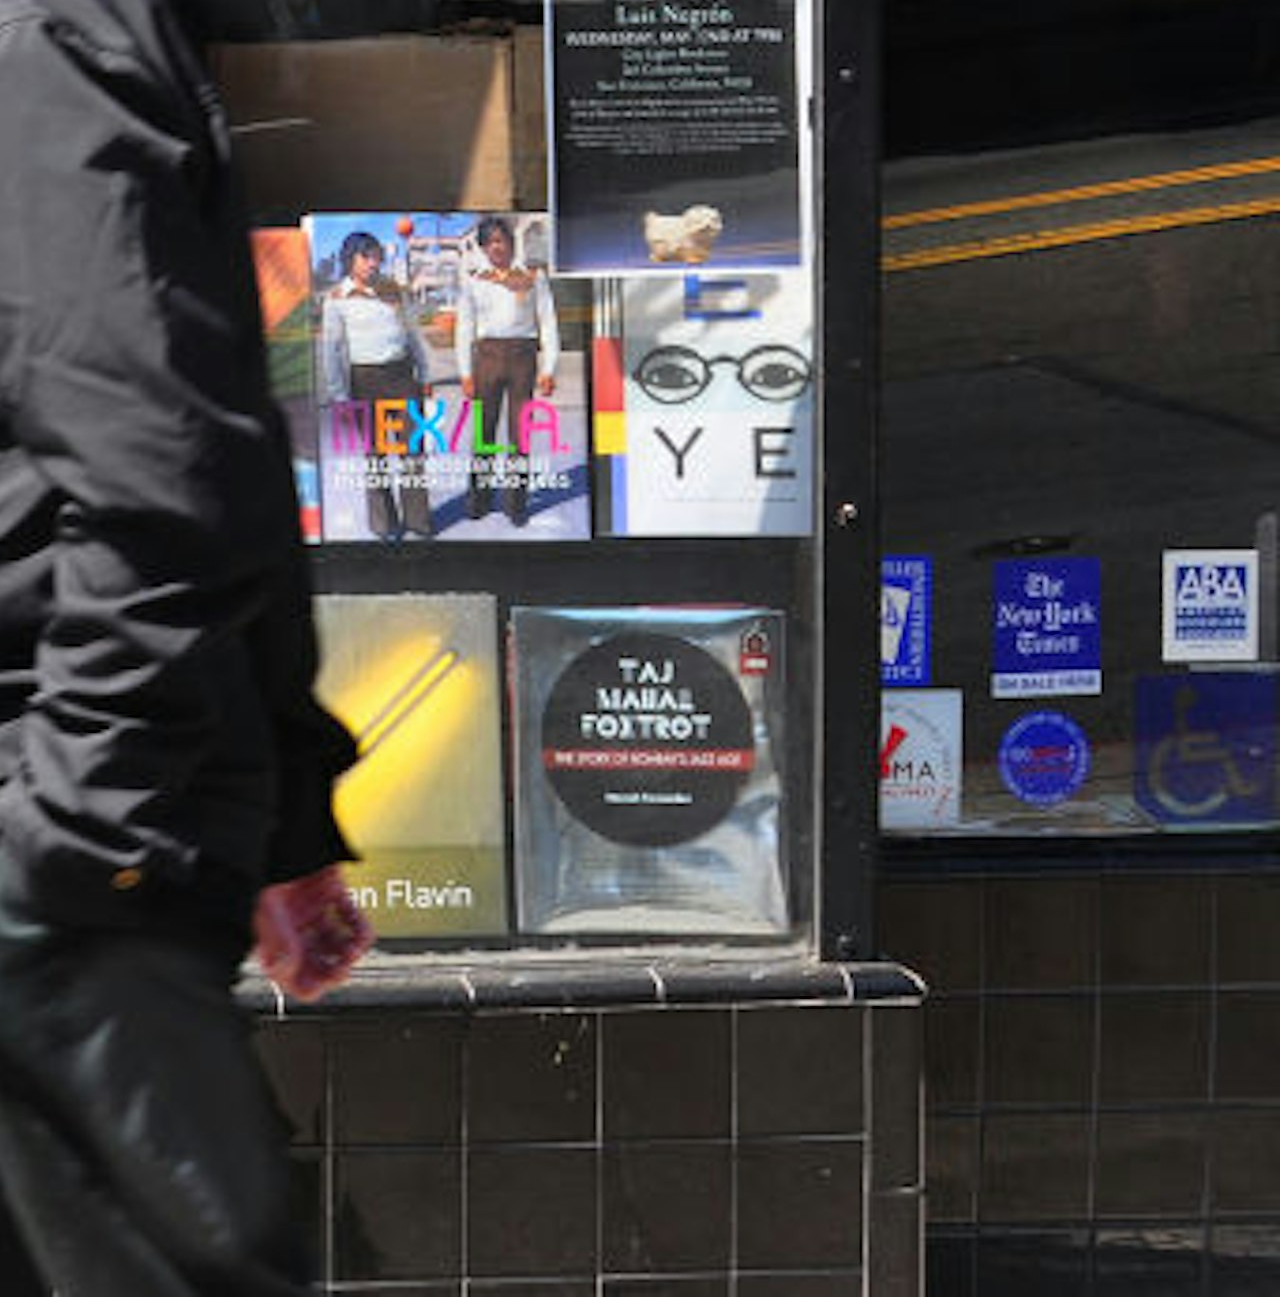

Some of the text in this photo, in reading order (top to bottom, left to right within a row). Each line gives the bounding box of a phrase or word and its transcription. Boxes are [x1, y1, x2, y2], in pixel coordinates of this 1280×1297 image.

[616, 5, 656, 25] Luis
[1024, 571, 1065, 599] The
[1177, 563, 1246, 599] ABA
[996, 602, 1098, 631] New York
[1015, 631, 1080, 656] Times
[617, 658, 676, 685] TAJ
[595, 687, 697, 712] MAHAL
[579, 713, 713, 740] FOXTROT
[346, 879, 473, 909] an Flavin
